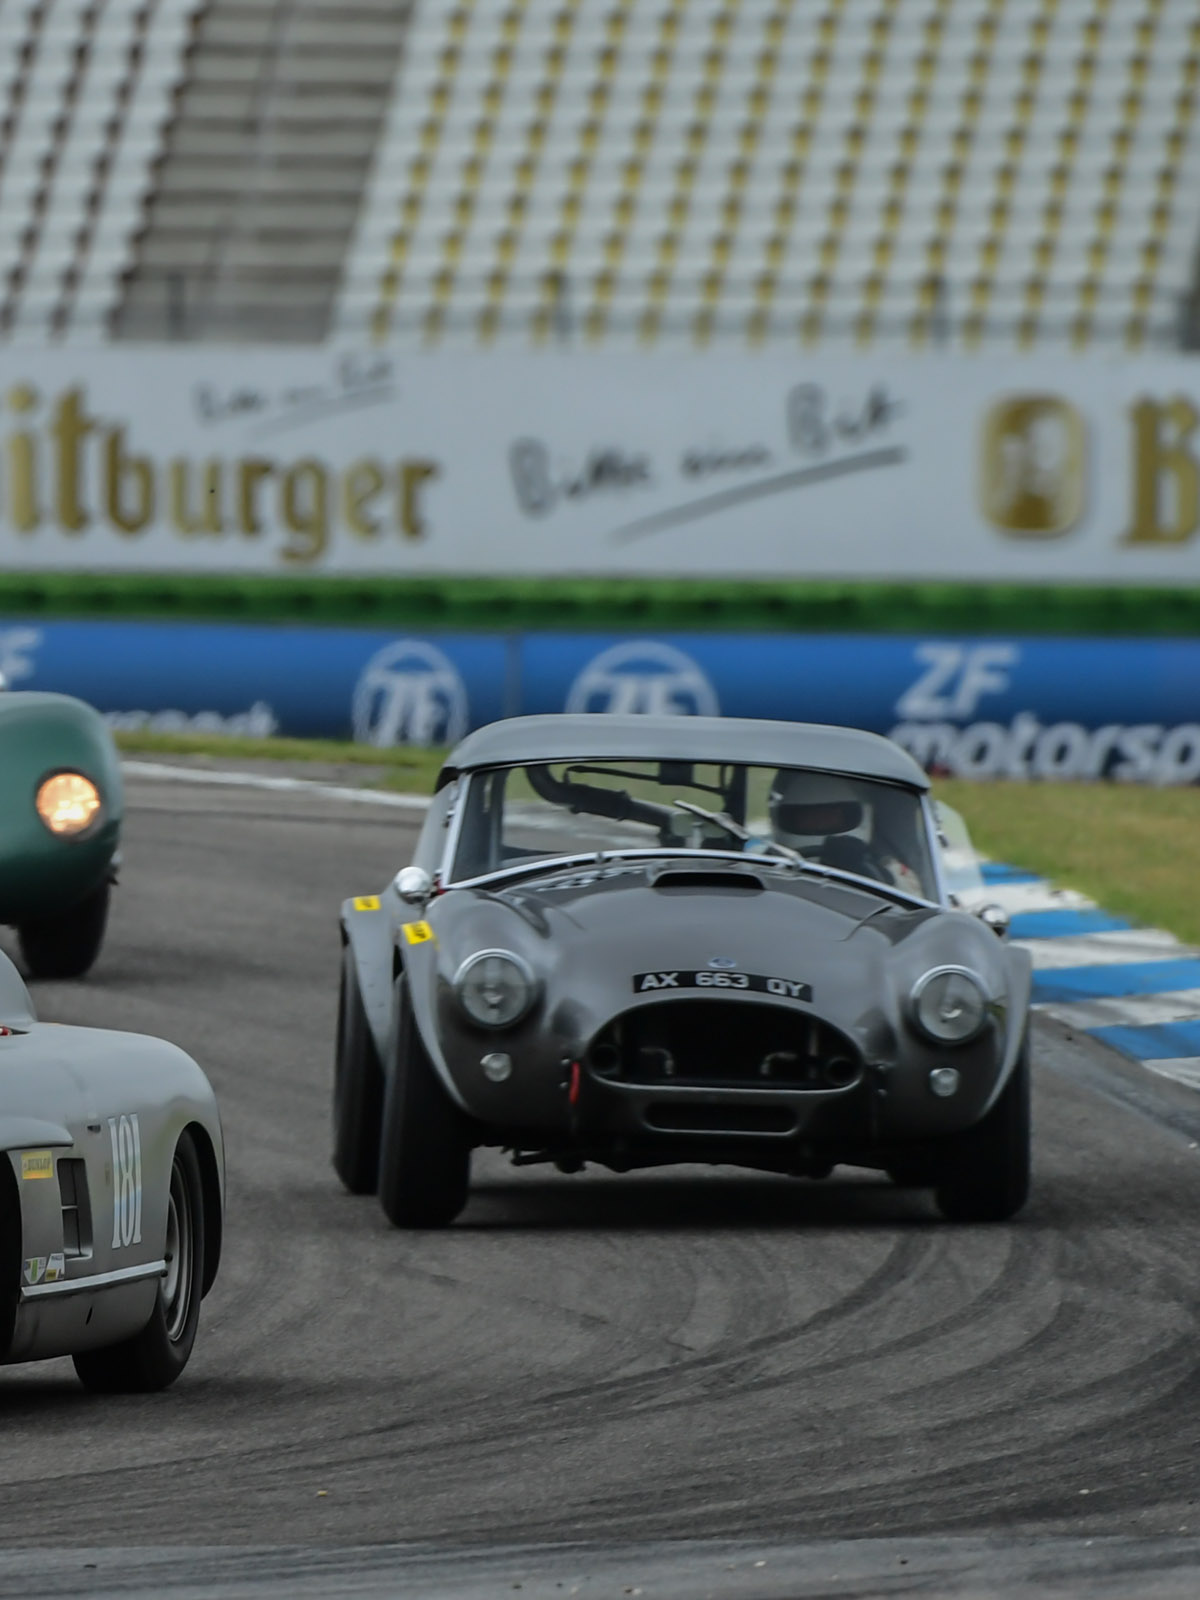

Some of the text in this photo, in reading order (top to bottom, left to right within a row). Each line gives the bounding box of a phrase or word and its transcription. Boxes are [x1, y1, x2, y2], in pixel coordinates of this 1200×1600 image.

[898, 643, 1020, 718] ZF
[640, 972, 679, 990] AX
[695, 972, 749, 988] 663
[108, 1113, 142, 1249] 181
